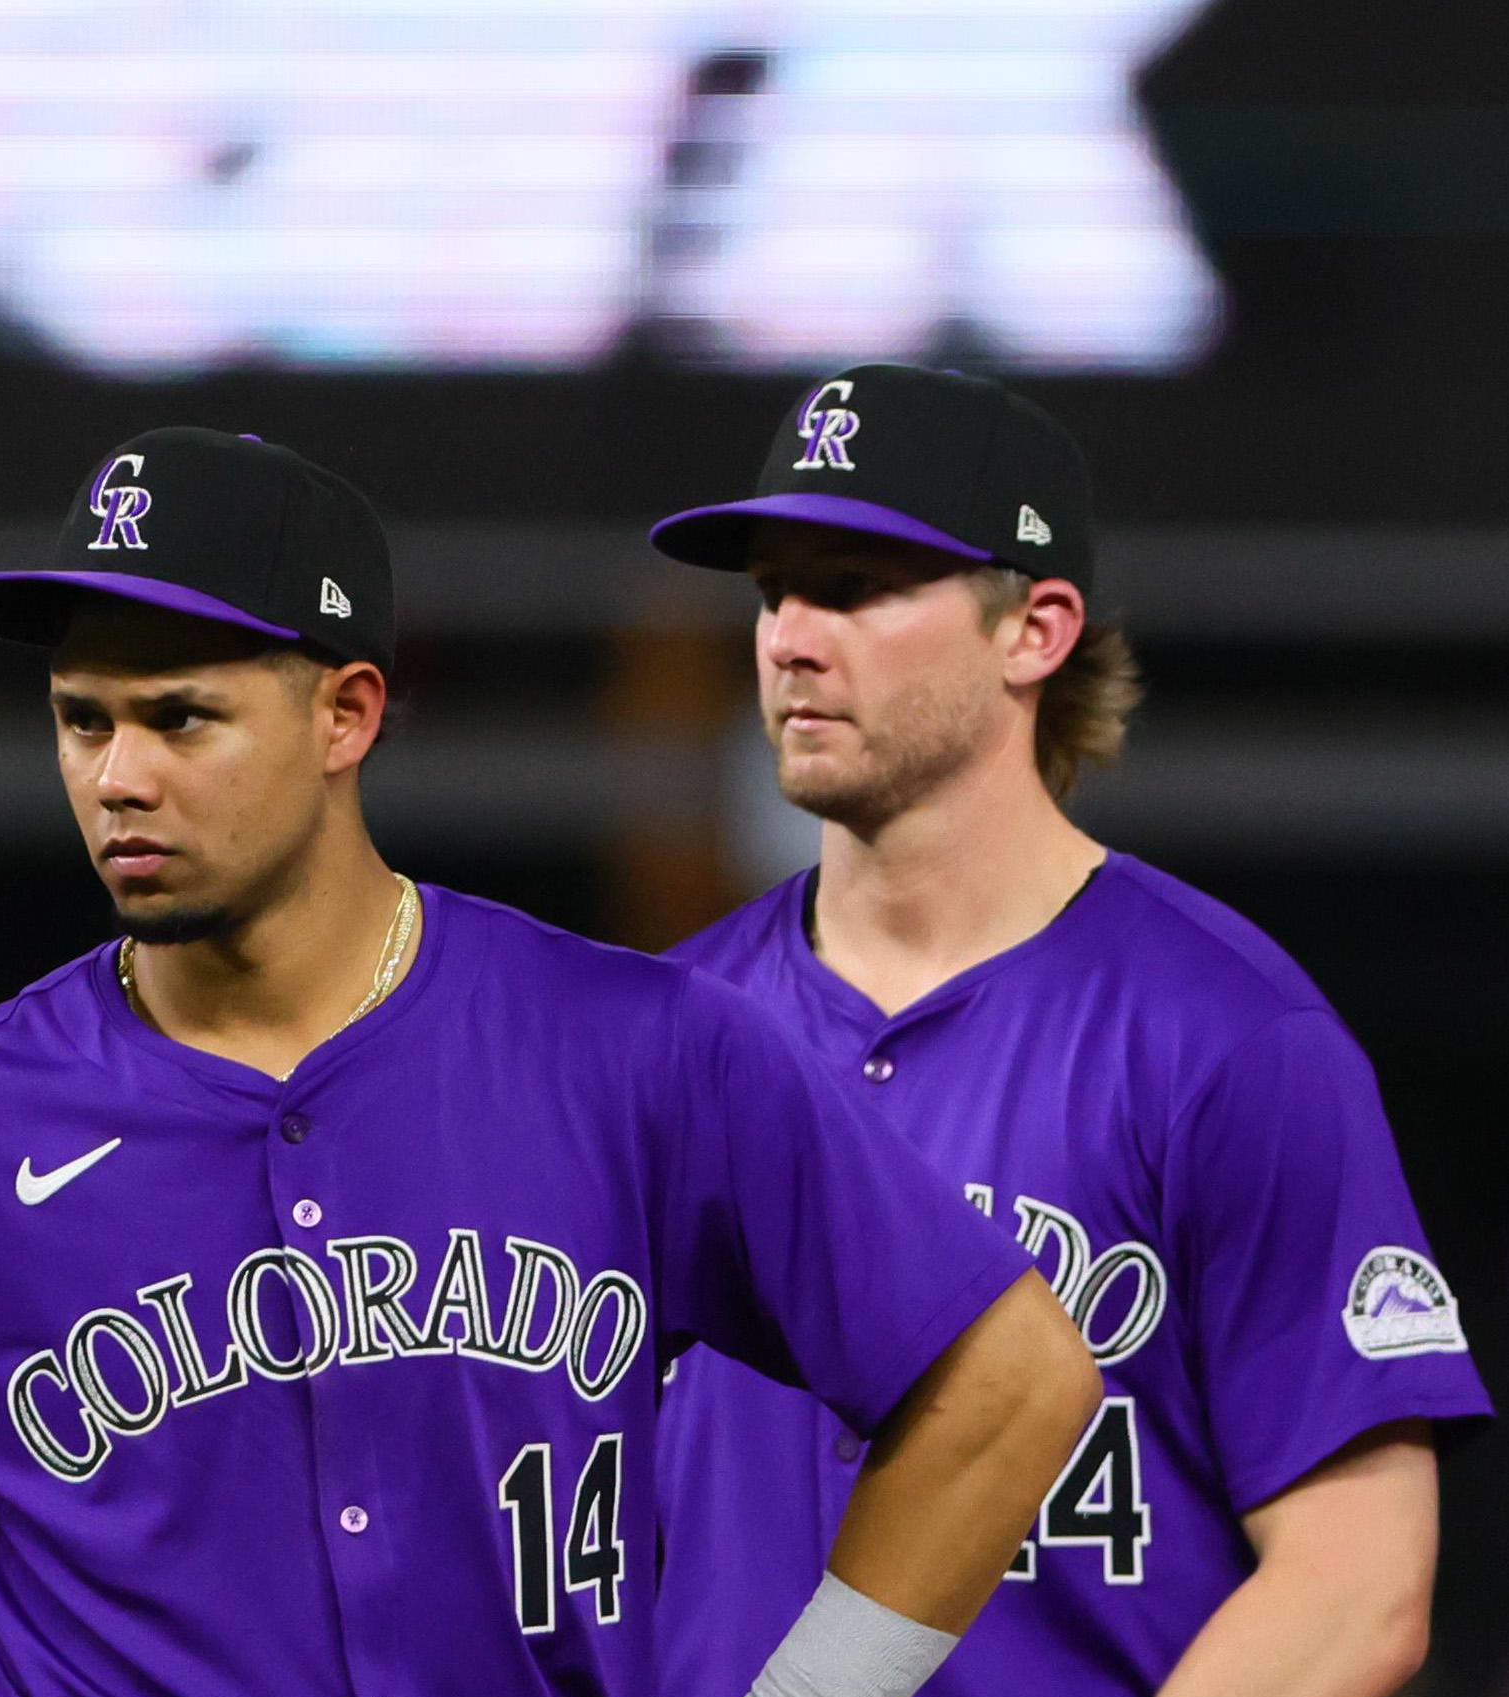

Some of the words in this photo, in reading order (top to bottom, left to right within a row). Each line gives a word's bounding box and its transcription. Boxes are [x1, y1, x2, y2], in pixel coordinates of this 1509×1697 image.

[6, 1228, 648, 1484] COLORADO
[498, 1431, 626, 1636] 14
[1002, 1396, 1152, 1586] 4
